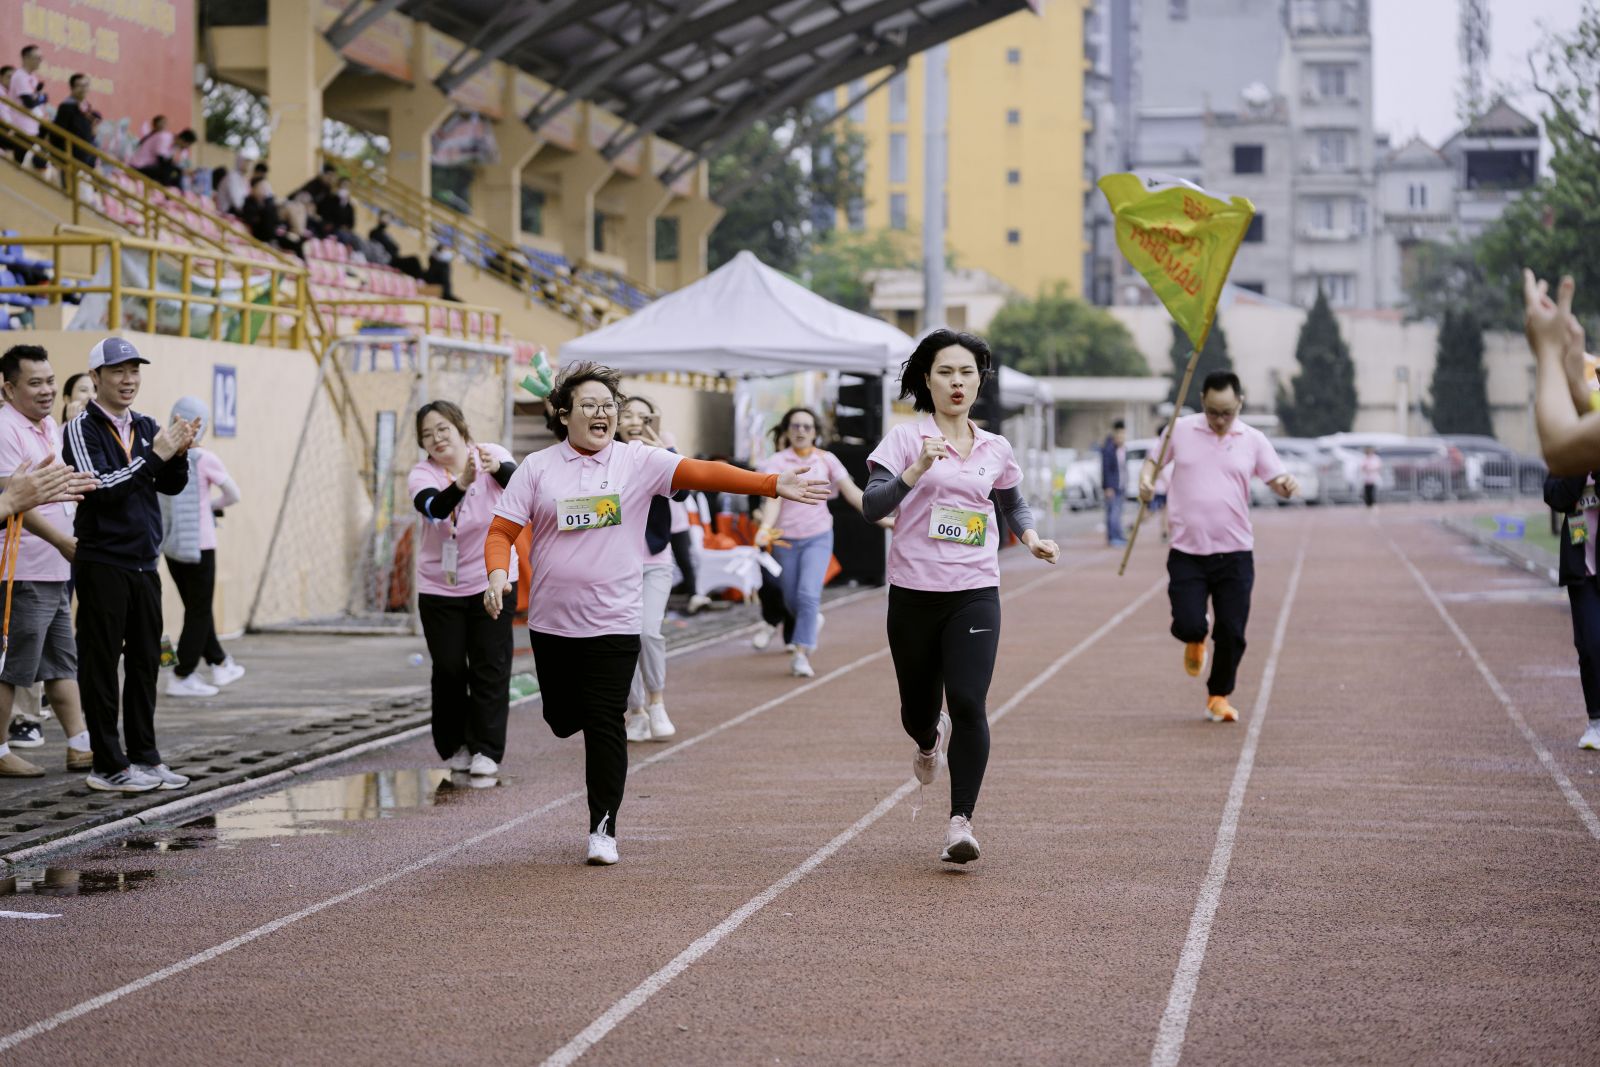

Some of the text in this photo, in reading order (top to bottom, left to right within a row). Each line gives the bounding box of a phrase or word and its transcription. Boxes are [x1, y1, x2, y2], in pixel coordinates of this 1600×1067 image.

[1580, 496, 1597, 506] 014
[566, 514, 591, 526] 015
[937, 523, 962, 538] 060
